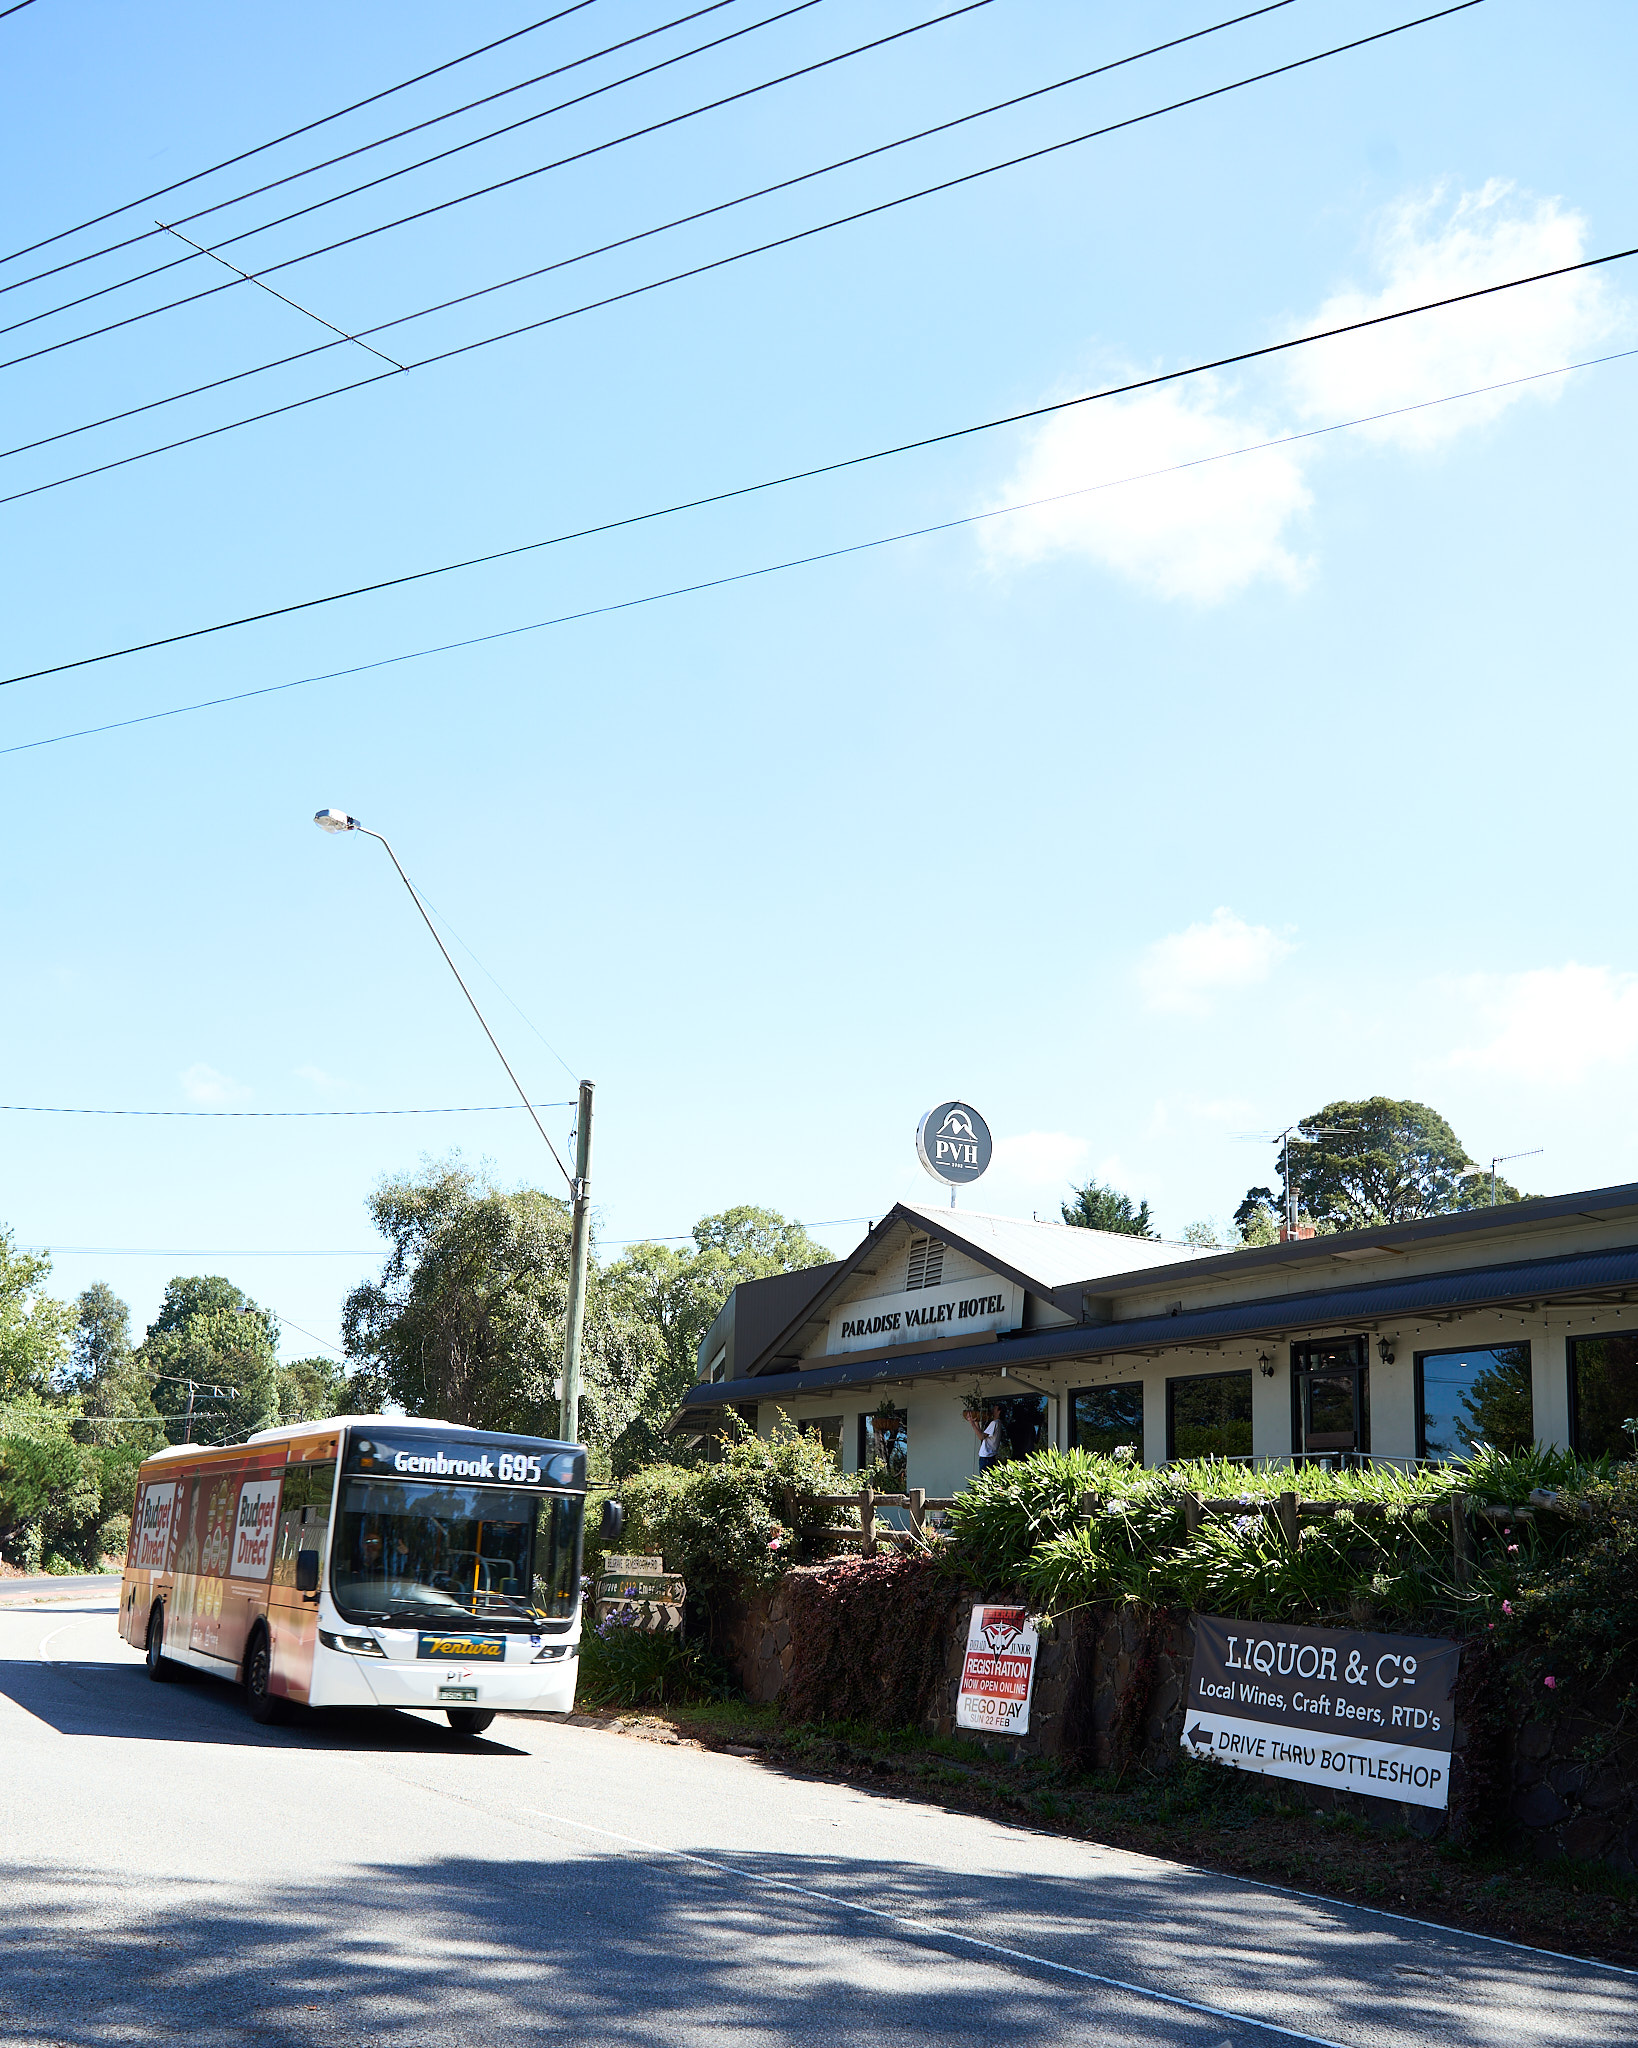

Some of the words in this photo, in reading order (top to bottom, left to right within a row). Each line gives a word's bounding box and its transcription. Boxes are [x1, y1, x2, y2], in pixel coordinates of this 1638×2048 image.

[936, 1140, 978, 1164] PVH
[841, 1312, 901, 1338] PARADISE
[905, 1302, 956, 1327] VALLEY
[958, 1294, 1005, 1319] HOTEL
[394, 1451, 495, 1478] Gembrook
[498, 1453, 542, 1483] 695
[143, 1495, 172, 1538] Budget
[239, 1493, 276, 1537] Budget
[141, 1532, 166, 1566] Direct
[237, 1531, 269, 1566] Direct
[421, 1636, 502, 1656] Ventura
[1225, 1636, 1338, 1681] LIQUOR
[1344, 1650, 1369, 1686] &
[966, 1658, 1029, 1679] REGISTRATION
[963, 1678, 978, 1690] NOW
[980, 1680, 998, 1692] OPEN
[999, 1682, 1027, 1695] ONLINE
[964, 1697, 996, 1715] REGO
[998, 1701, 1023, 1718] DAY
[970, 1713, 984, 1723] SUN
[985, 1715, 993, 1725] 22
[995, 1716, 1010, 1727] FEB
[1199, 1677, 1235, 1700] Local
[1239, 1683, 1287, 1711] Wines,
[1292, 1691, 1331, 1716] Craft
[1335, 1698, 1386, 1727] Beers,
[1391, 1705, 1441, 1732] RTD's
[1218, 1731, 1266, 1758] DRIVE
[1271, 1741, 1316, 1767] THRU
[1320, 1750, 1442, 1789] BOTTLESHOP
